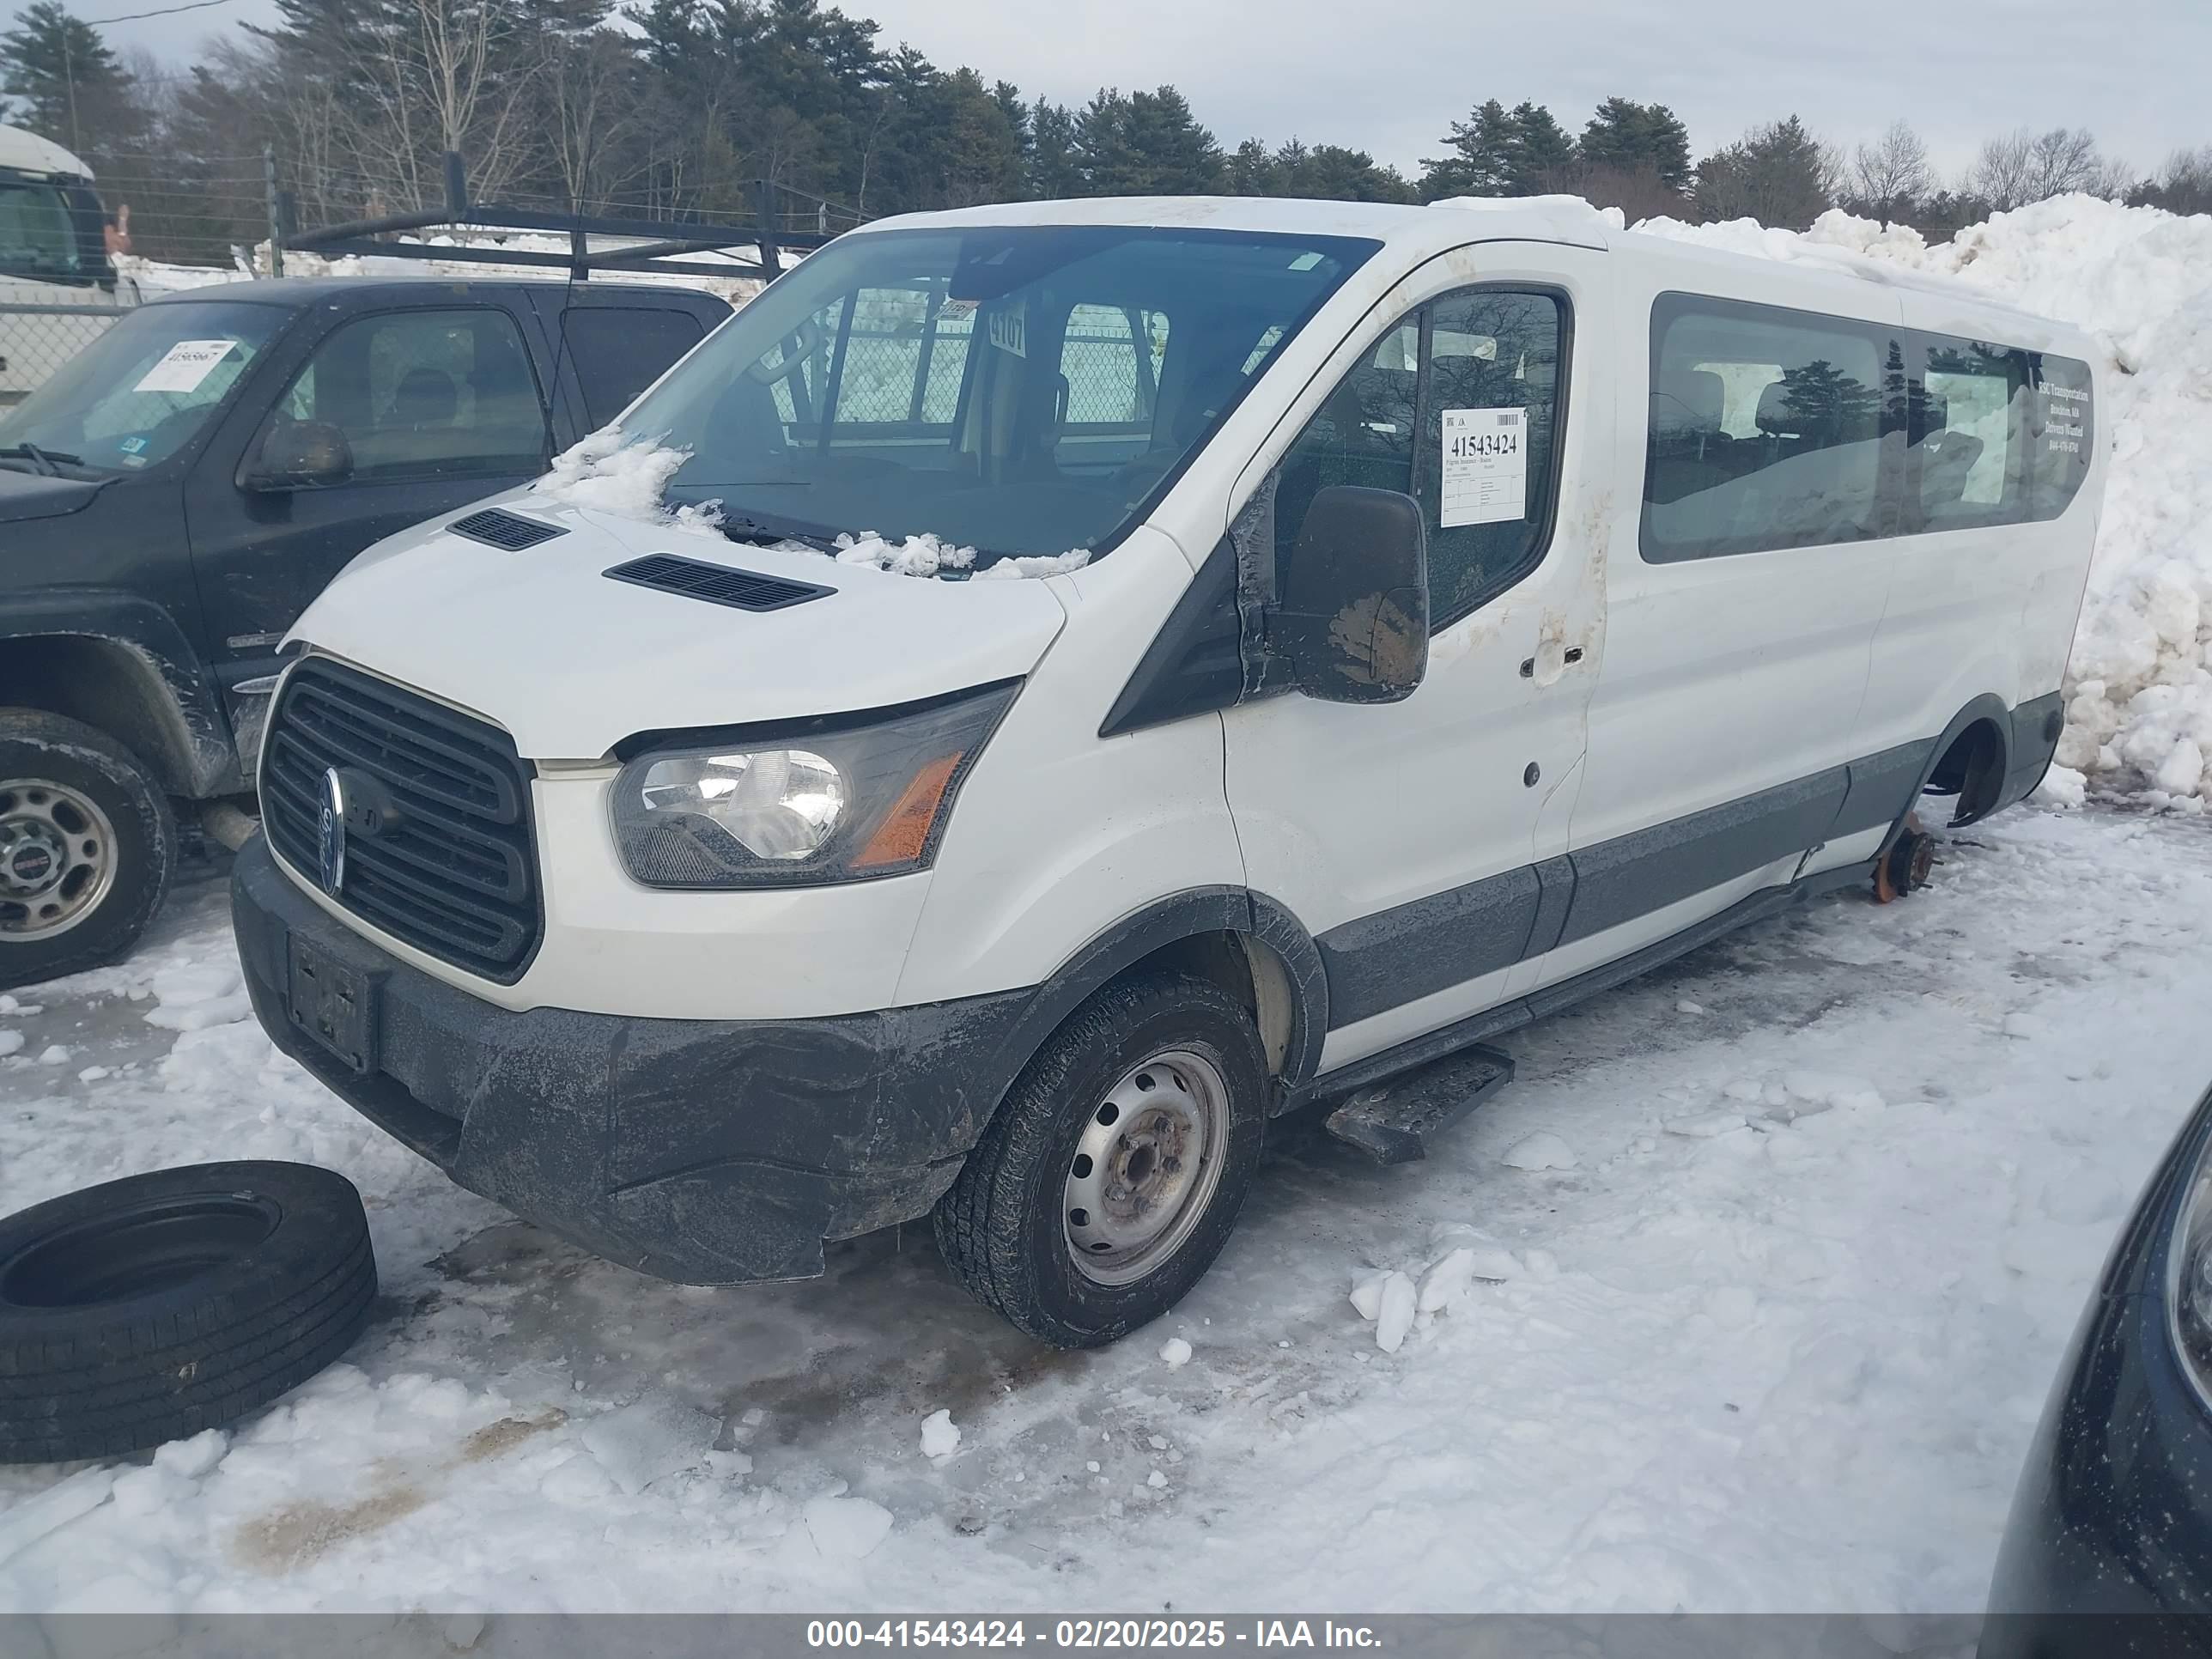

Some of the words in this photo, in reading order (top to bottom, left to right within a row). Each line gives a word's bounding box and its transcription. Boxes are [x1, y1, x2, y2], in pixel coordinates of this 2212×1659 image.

[990, 314, 1023, 350] 4107
[2051, 383, 2088, 402] Transportation
[2071, 407, 2080, 418] MA
[2045, 421, 2064, 435] Drivers
[2064, 423, 2083, 437] Wanted
[1451, 434, 1517, 457] 41543424
